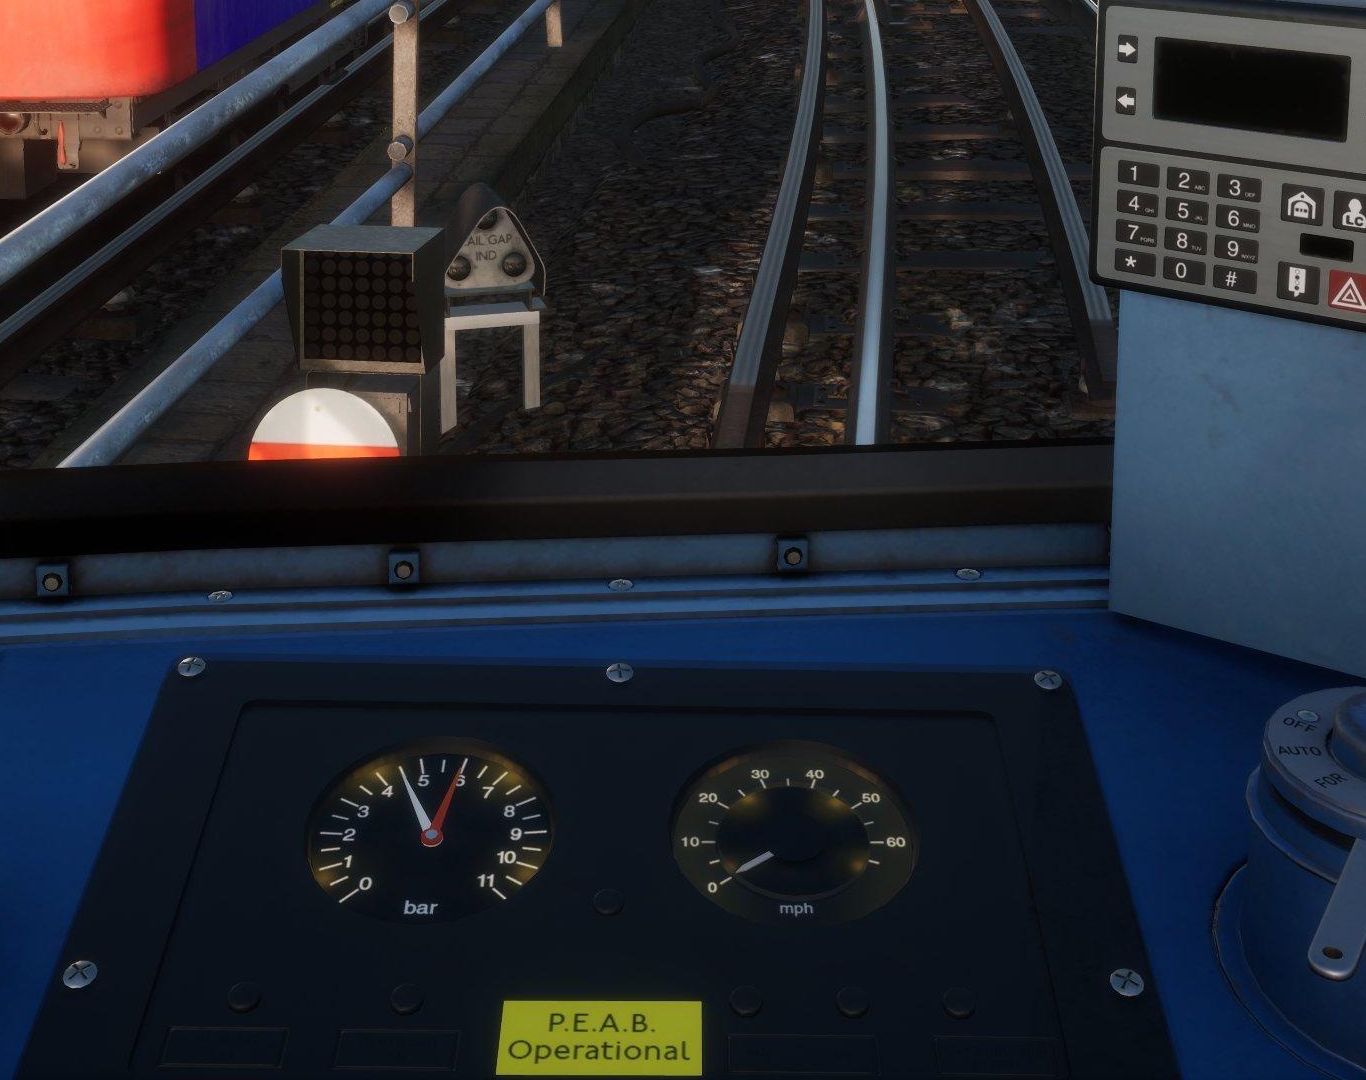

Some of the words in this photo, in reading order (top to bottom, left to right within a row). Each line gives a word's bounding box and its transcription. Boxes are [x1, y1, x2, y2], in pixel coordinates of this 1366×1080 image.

[1130, 165, 1138, 181] 1
[1178, 172, 1190, 189] 2
[1229, 179, 1241, 196] 3
[1128, 195, 1140, 211] 4
[1177, 202, 1189, 219] 5
[1228, 210, 1240, 227] 6
[1127, 224, 1139, 240] 7
[467, 235, 485, 247] AIL
[488, 233, 513, 245] GAP
[1176, 232, 1188, 249] 8
[476, 250, 497, 261] IND
[1227, 240, 1239, 257] 9
[1175, 261, 1188, 279] 0
[1283, 717, 1317, 733] OFF
[1278, 746, 1322, 756] AUTO
[418, 774, 430, 787] 5
[455, 775, 466, 787] 6
[751, 769, 770, 780] 30
[805, 769, 825, 779] 40
[1315, 773, 1347, 789] FOR
[381, 785, 394, 798] 4
[482, 786, 495, 799] 7
[699, 793, 718, 803] 20
[861, 793, 881, 803] 50
[357, 805, 370, 818] 3
[503, 805, 516, 818] 8
[342, 829, 356, 841] 2
[510, 828, 523, 841] 9
[680, 837, 700, 847] 10
[886, 837, 906, 847] 60
[343, 855, 353, 869] 1
[496, 851, 517, 864] 10
[359, 877, 372, 890] 0
[477, 873, 495, 888] 11
[707, 882, 718, 893] 0
[403, 900, 438, 915] bar
[779, 903, 813, 916] mph
[548, 1013, 655, 1033] P.E.A.B.
[507, 1039, 691, 1064] Operational
